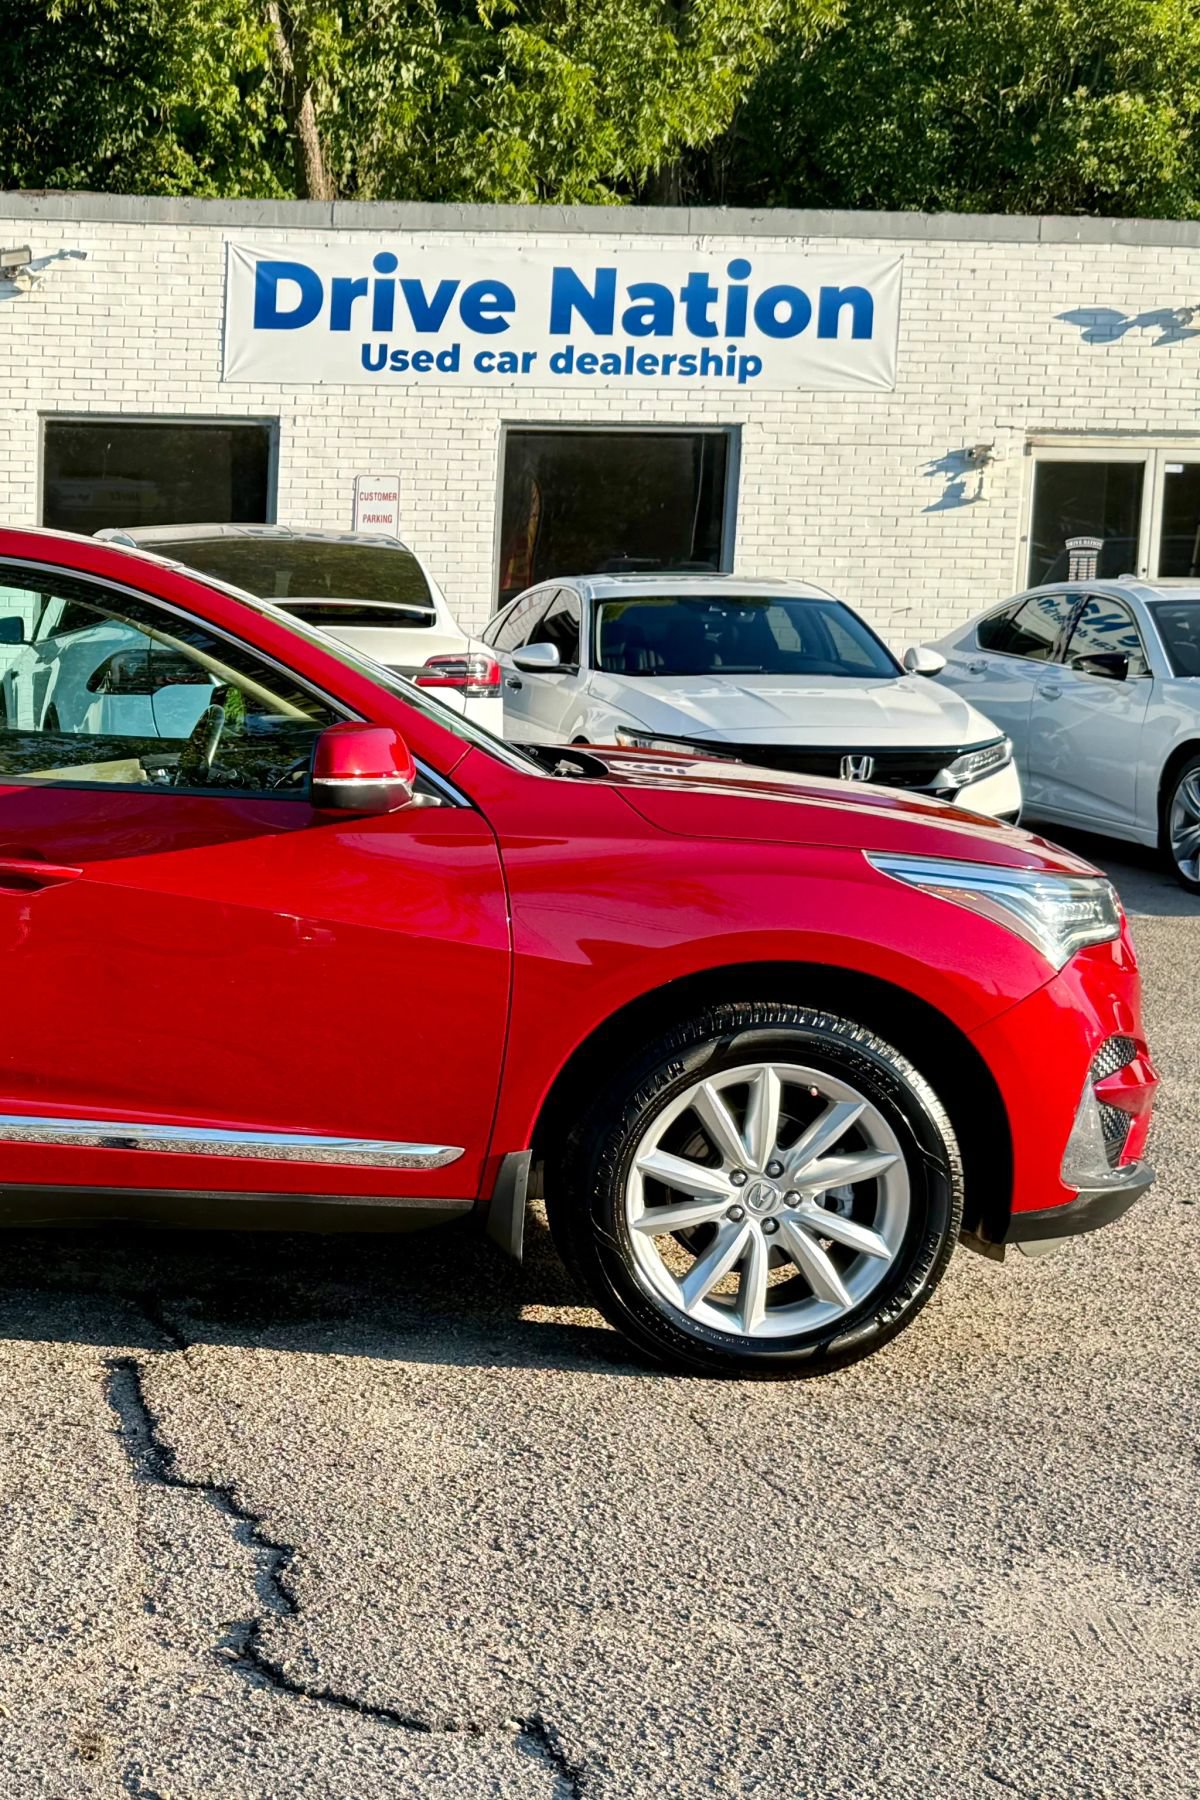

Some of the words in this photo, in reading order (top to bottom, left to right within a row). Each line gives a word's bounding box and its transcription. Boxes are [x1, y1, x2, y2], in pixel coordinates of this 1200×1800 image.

[252, 251, 517, 336] Drive
[548, 258, 875, 341] Nation
[361, 343, 461, 373] Used
[473, 351, 537, 374] car
[549, 345, 763, 385] dealership
[359, 491, 397, 502] CUSTOMER
[362, 513, 393, 524] PARKING
